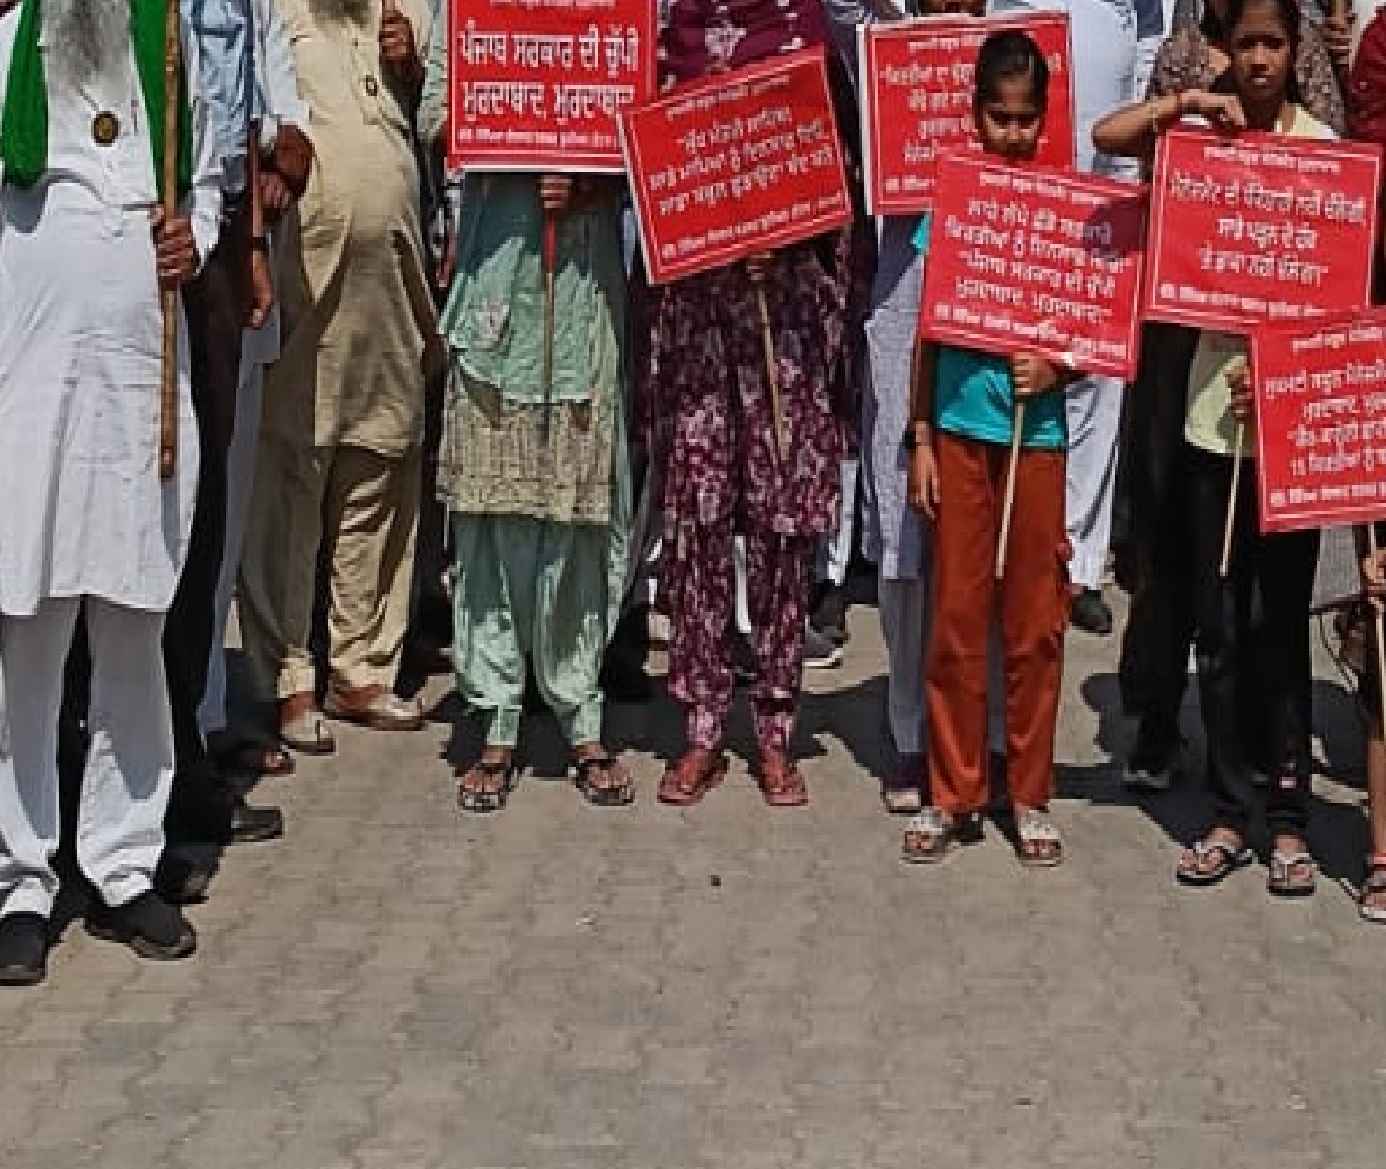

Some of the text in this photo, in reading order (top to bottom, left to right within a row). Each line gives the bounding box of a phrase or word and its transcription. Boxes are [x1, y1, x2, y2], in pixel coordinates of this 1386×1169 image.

[457, 18, 507, 67] ਪੰਜਾਬ
[510, 33, 574, 69] ਸਰਕਾਰ
[578, 22, 600, 70] ਦੀ
